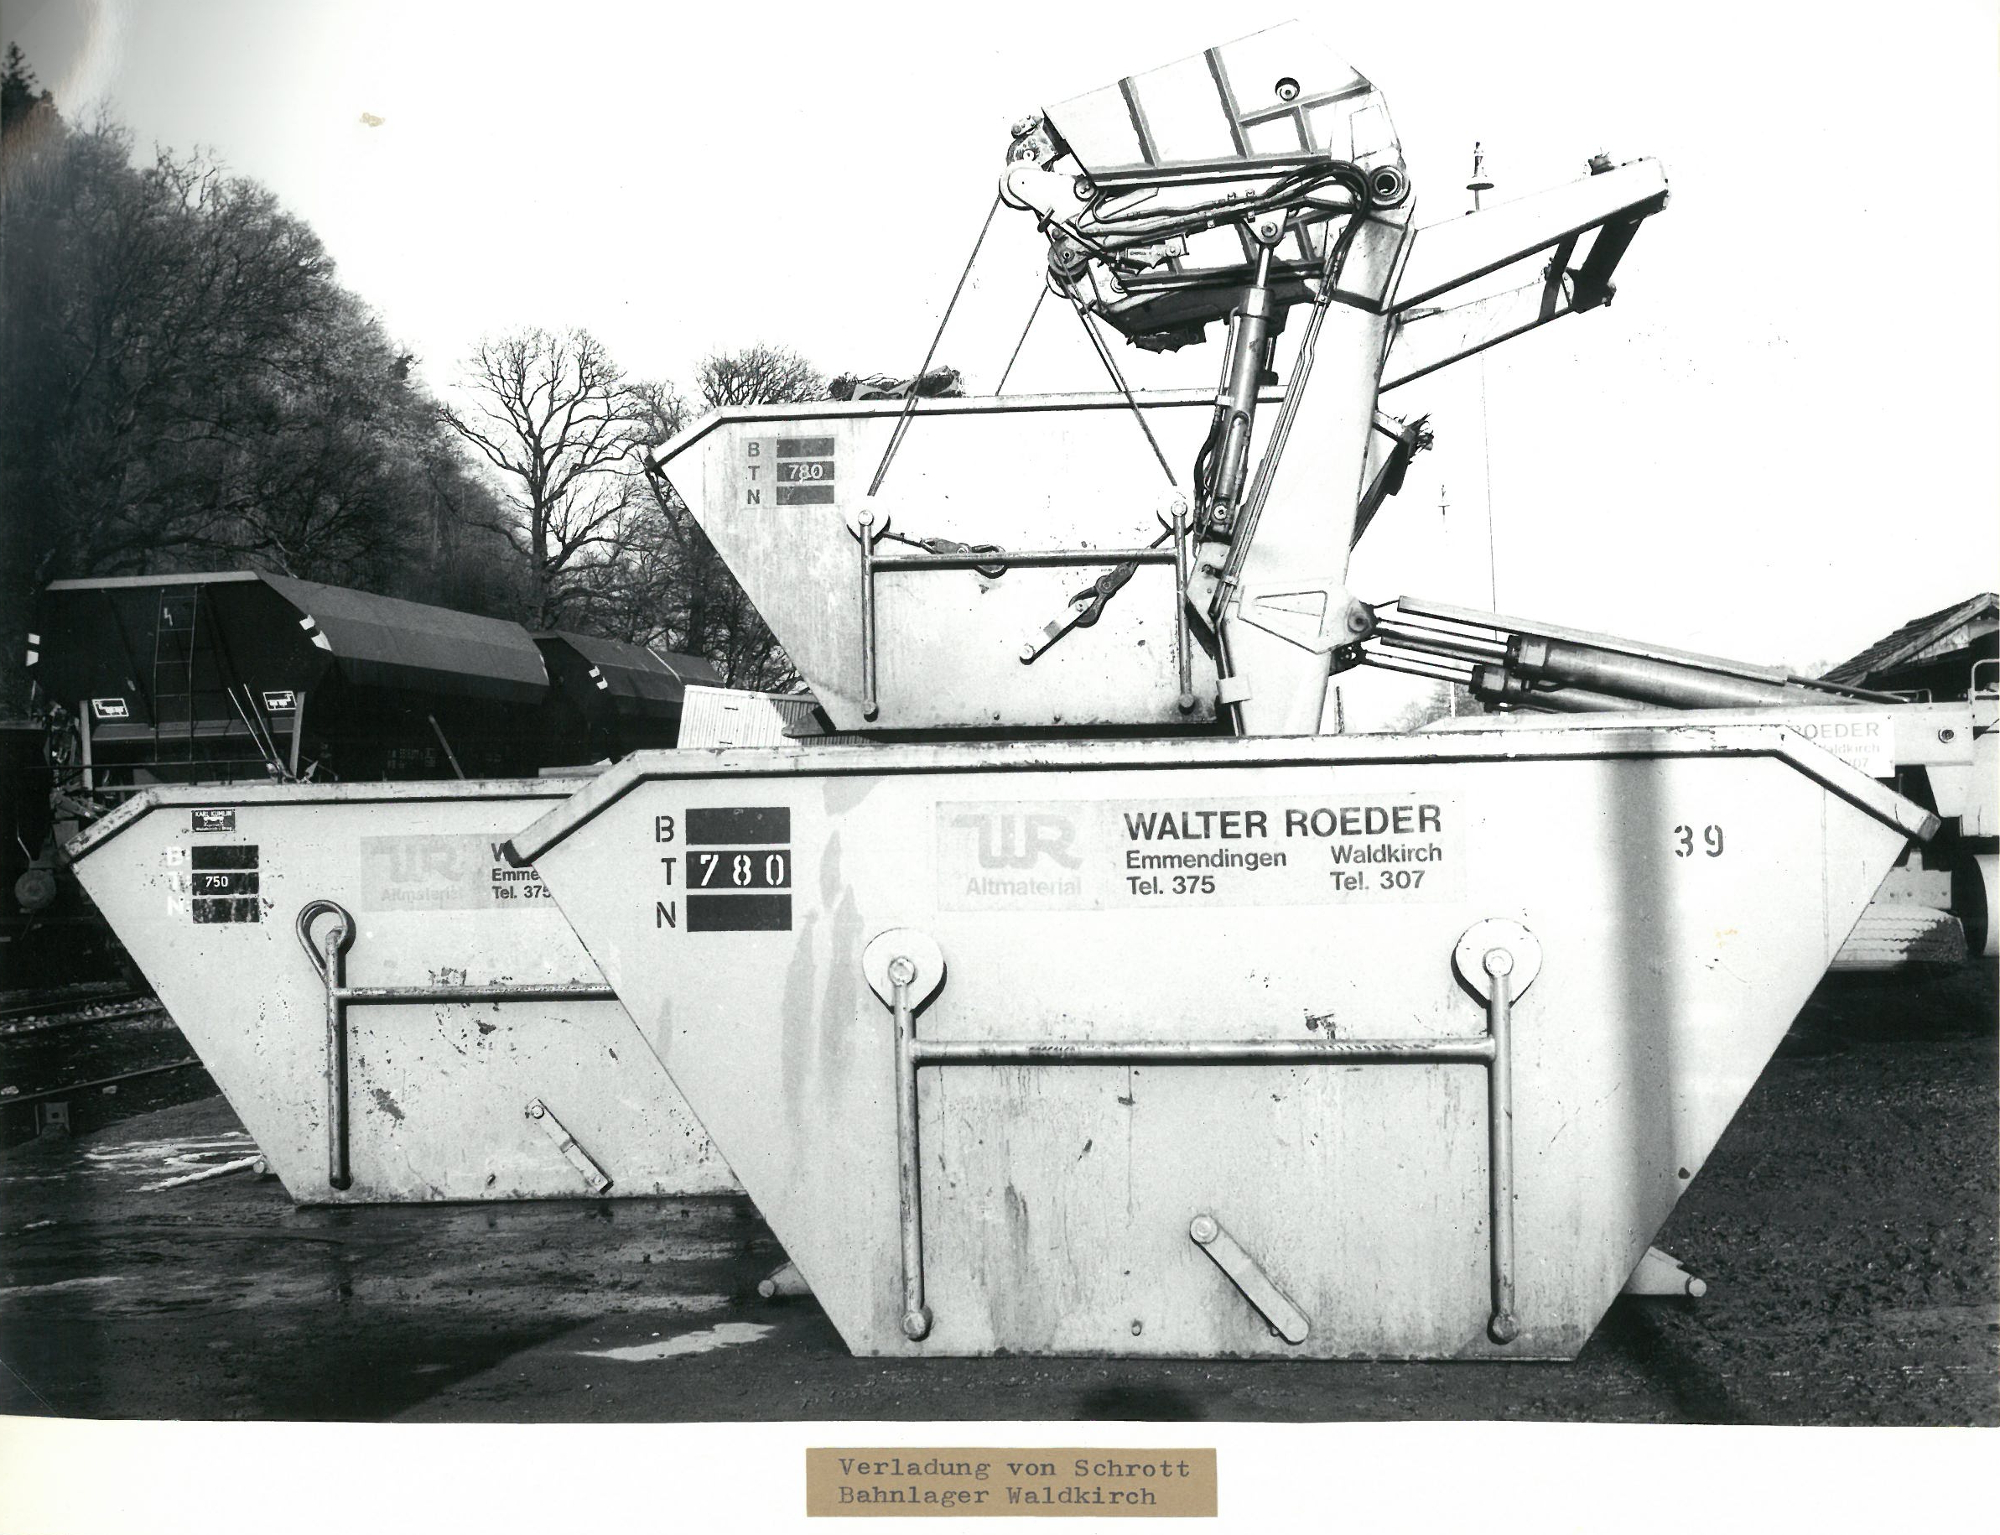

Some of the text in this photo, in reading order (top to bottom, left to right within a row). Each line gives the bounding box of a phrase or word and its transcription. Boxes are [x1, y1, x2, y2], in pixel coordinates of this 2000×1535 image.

[747, 442, 760, 457] B
[747, 464, 823, 480] T 780
[747, 489, 760, 504] N
[1823, 742, 1880, 754] aldkirch
[655, 815, 675, 843] B
[1123, 804, 1442, 841] WALTER ROEDER
[1673, 824, 1724, 858] 39
[1126, 842, 1443, 871] Emmendingen Waldkirch
[660, 854, 784, 886] T 780
[1330, 869, 1426, 891] Tel. 307
[205, 876, 229, 888] 750
[492, 885, 551, 899] Tel. 375
[966, 876, 1082, 897] Altmaterial
[1126, 875, 1216, 895] Tel. 375
[656, 901, 676, 929] N
